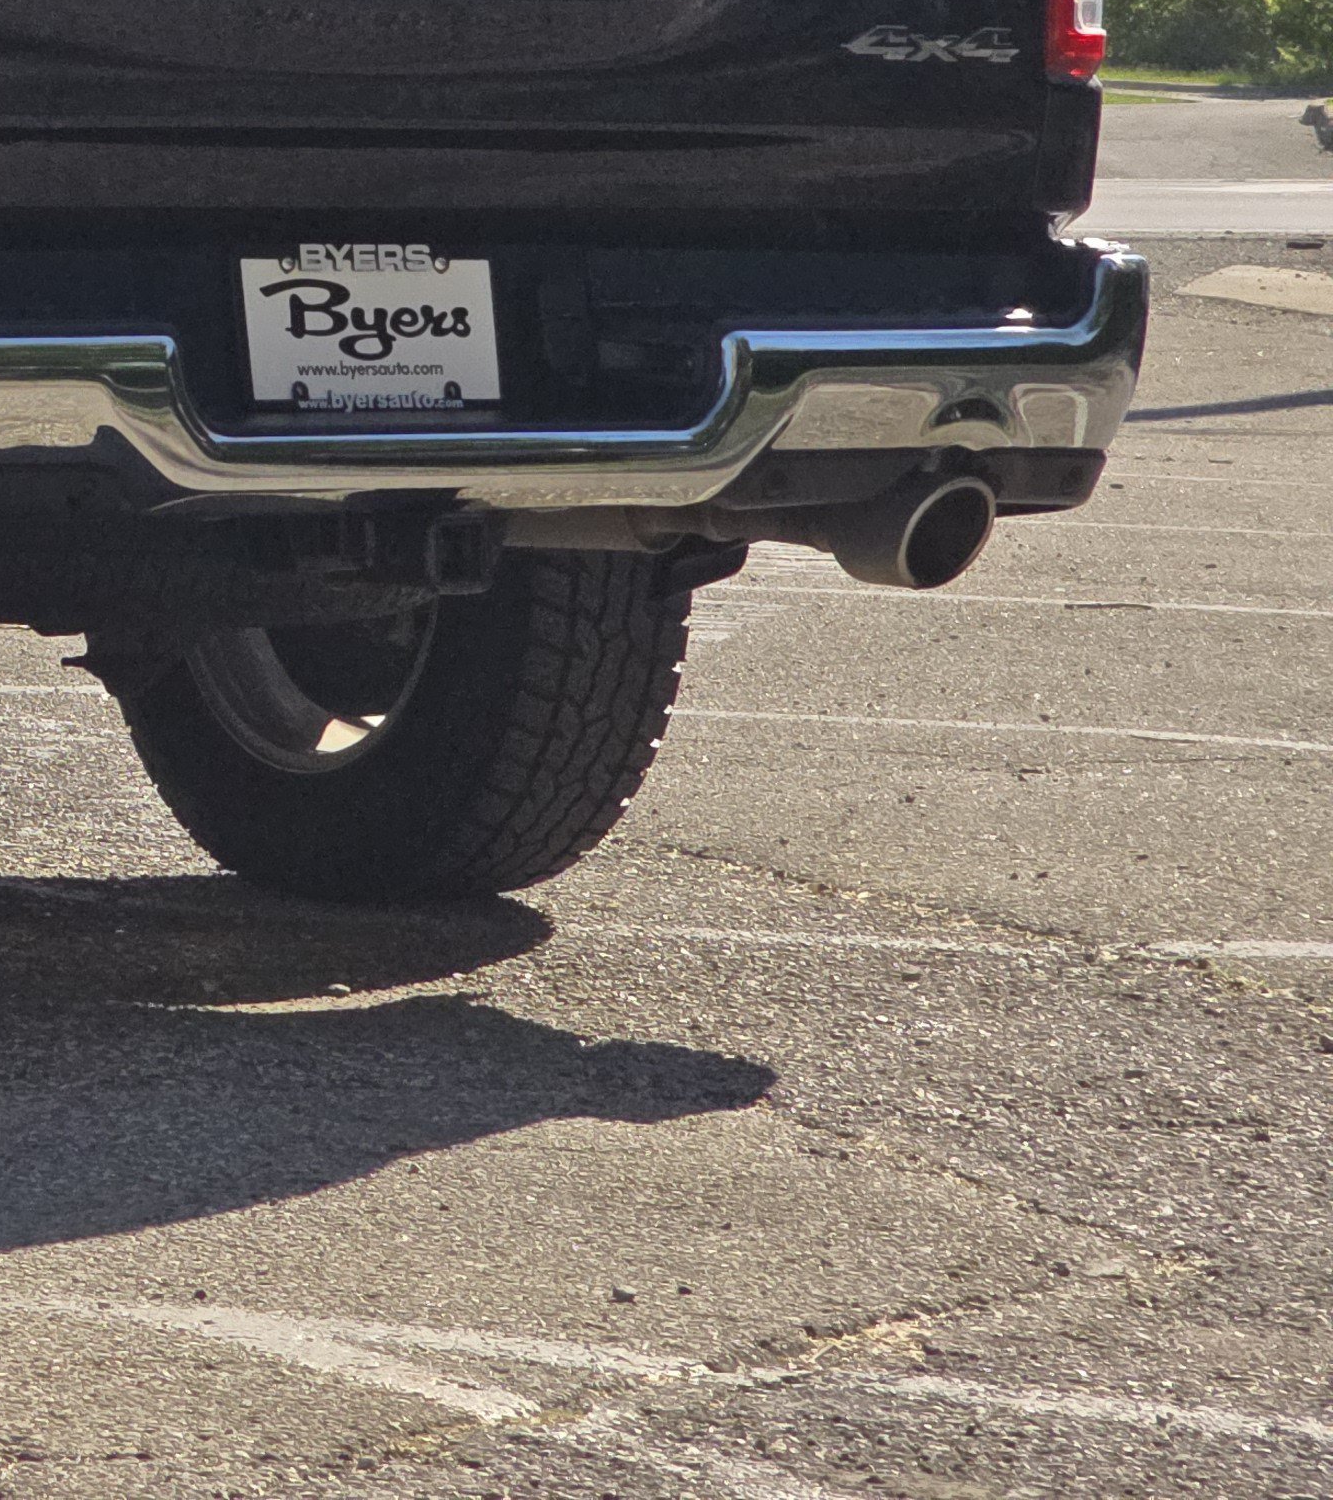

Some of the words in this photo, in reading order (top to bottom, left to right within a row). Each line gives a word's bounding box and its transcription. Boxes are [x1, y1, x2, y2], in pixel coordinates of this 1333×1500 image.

[298, 243, 432, 272] BYERS
[259, 278, 471, 361] Byers
[297, 361, 444, 379] www.byersauto.com
